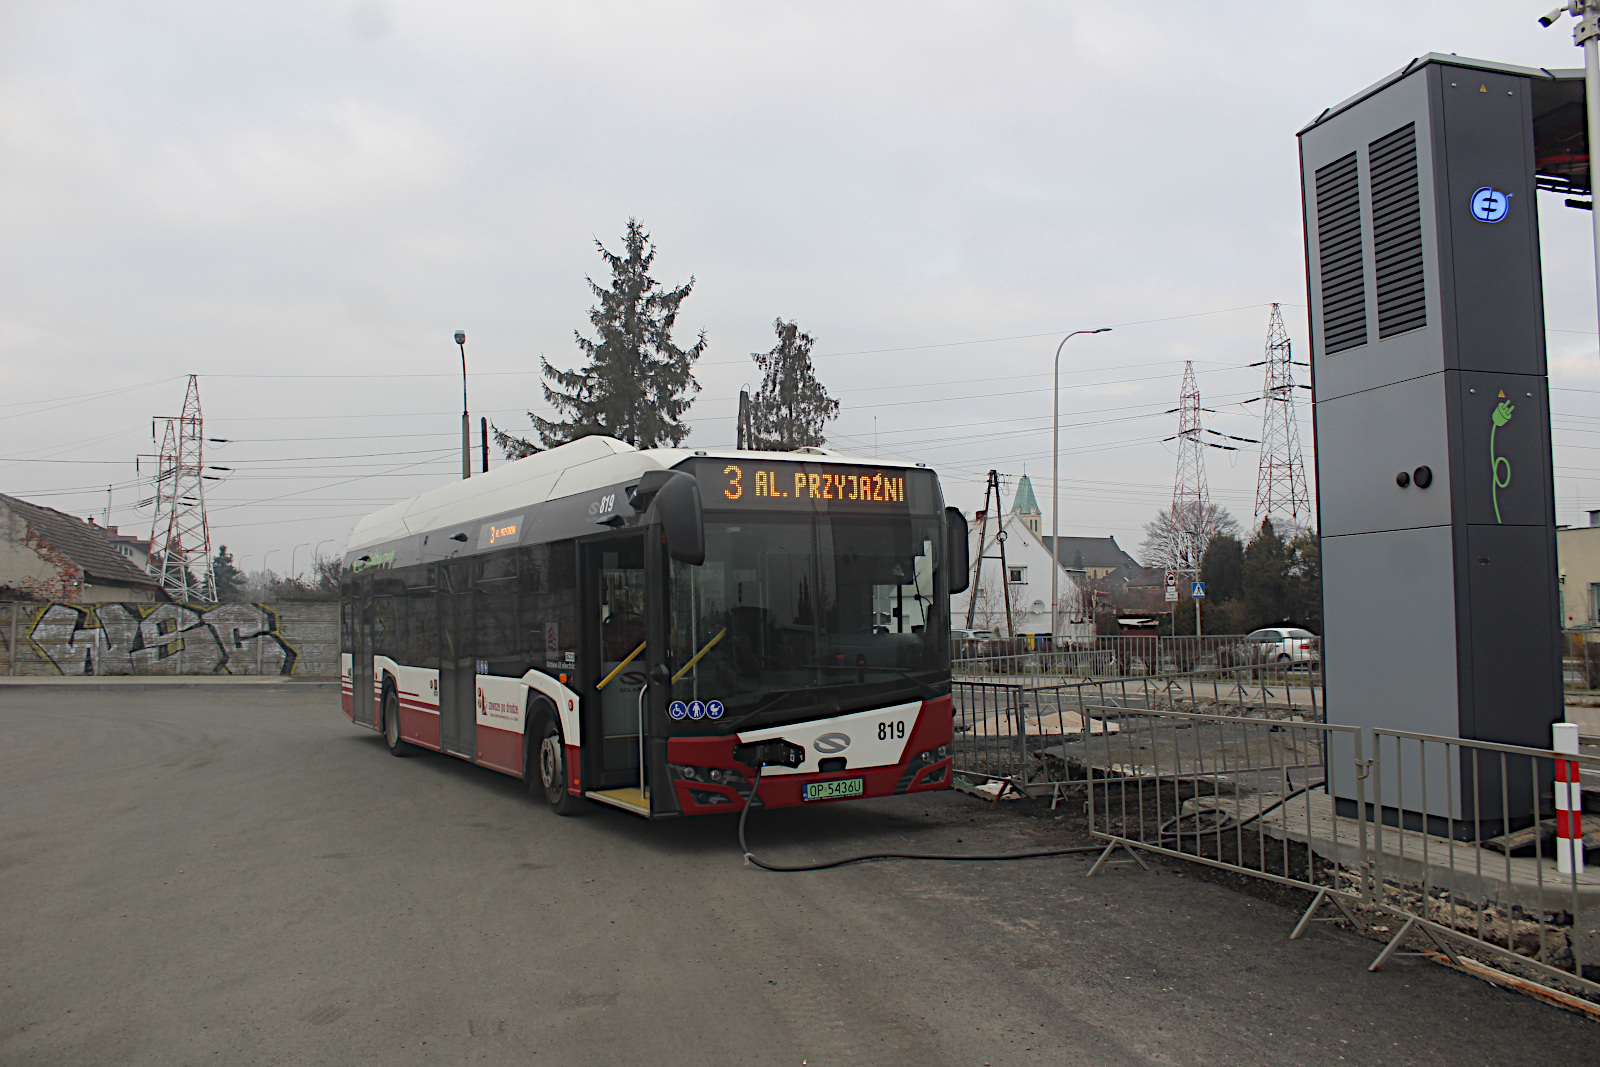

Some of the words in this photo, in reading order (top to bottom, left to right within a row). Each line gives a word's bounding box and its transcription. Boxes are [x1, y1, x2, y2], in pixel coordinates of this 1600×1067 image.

[723, 465, 742, 499] 3
[755, 471, 788, 497] AL.
[794, 470, 904, 502] PRZYJAŹNI
[600, 494, 615, 513] 819
[878, 720, 905, 740] 819
[810, 784, 824, 797] OP
[828, 780, 861, 795] 5436U
